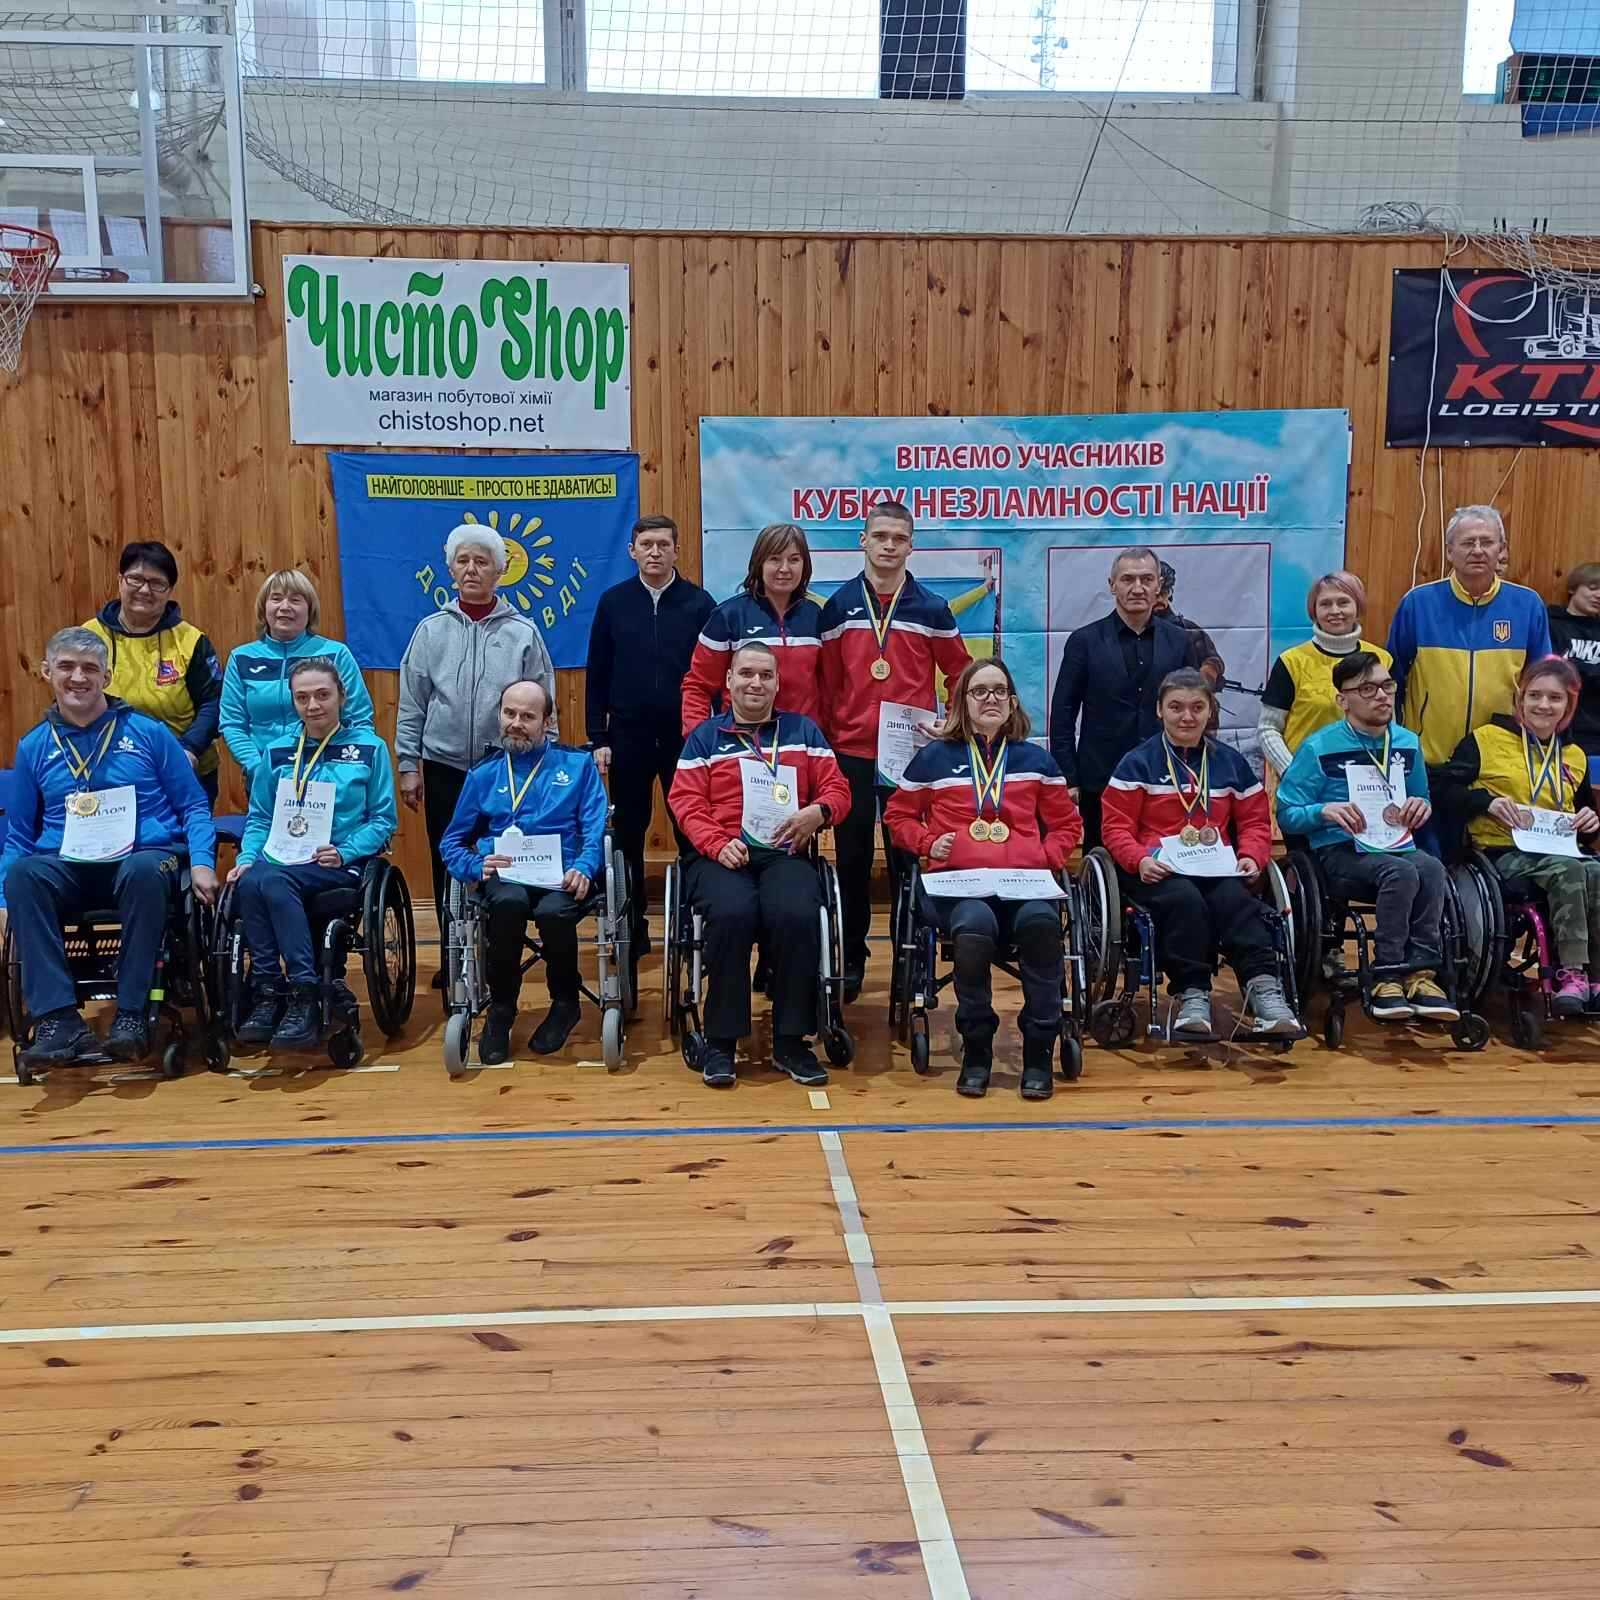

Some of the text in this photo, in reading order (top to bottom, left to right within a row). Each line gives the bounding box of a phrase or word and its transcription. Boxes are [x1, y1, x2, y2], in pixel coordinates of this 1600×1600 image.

[288, 264, 625, 410] Чисто Shop
[369, 390, 552, 406] магазин побутової хімії
[379, 410, 544, 436] chistoshop.net
[896, 443, 1165, 470] ВІТАЄМО УЧАСНИКІВ
[372, 475, 464, 496] НАЙГОЛОВНІШЕ
[477, 479, 523, 496] ПРОСТО
[526, 480, 541, 496] НЕ
[543, 477, 612, 499] ЗДАВАТИСЬ!
[914, 484, 1162, 518] НЕЗЛАМНОСТІ
[1172, 474, 1270, 519] НАЦІЇ
[887, 720, 921, 732] ДИПЛО
[512, 854, 552, 863] ИПЛОМ
[1177, 846, 1218, 858] ДИПЛОМ
